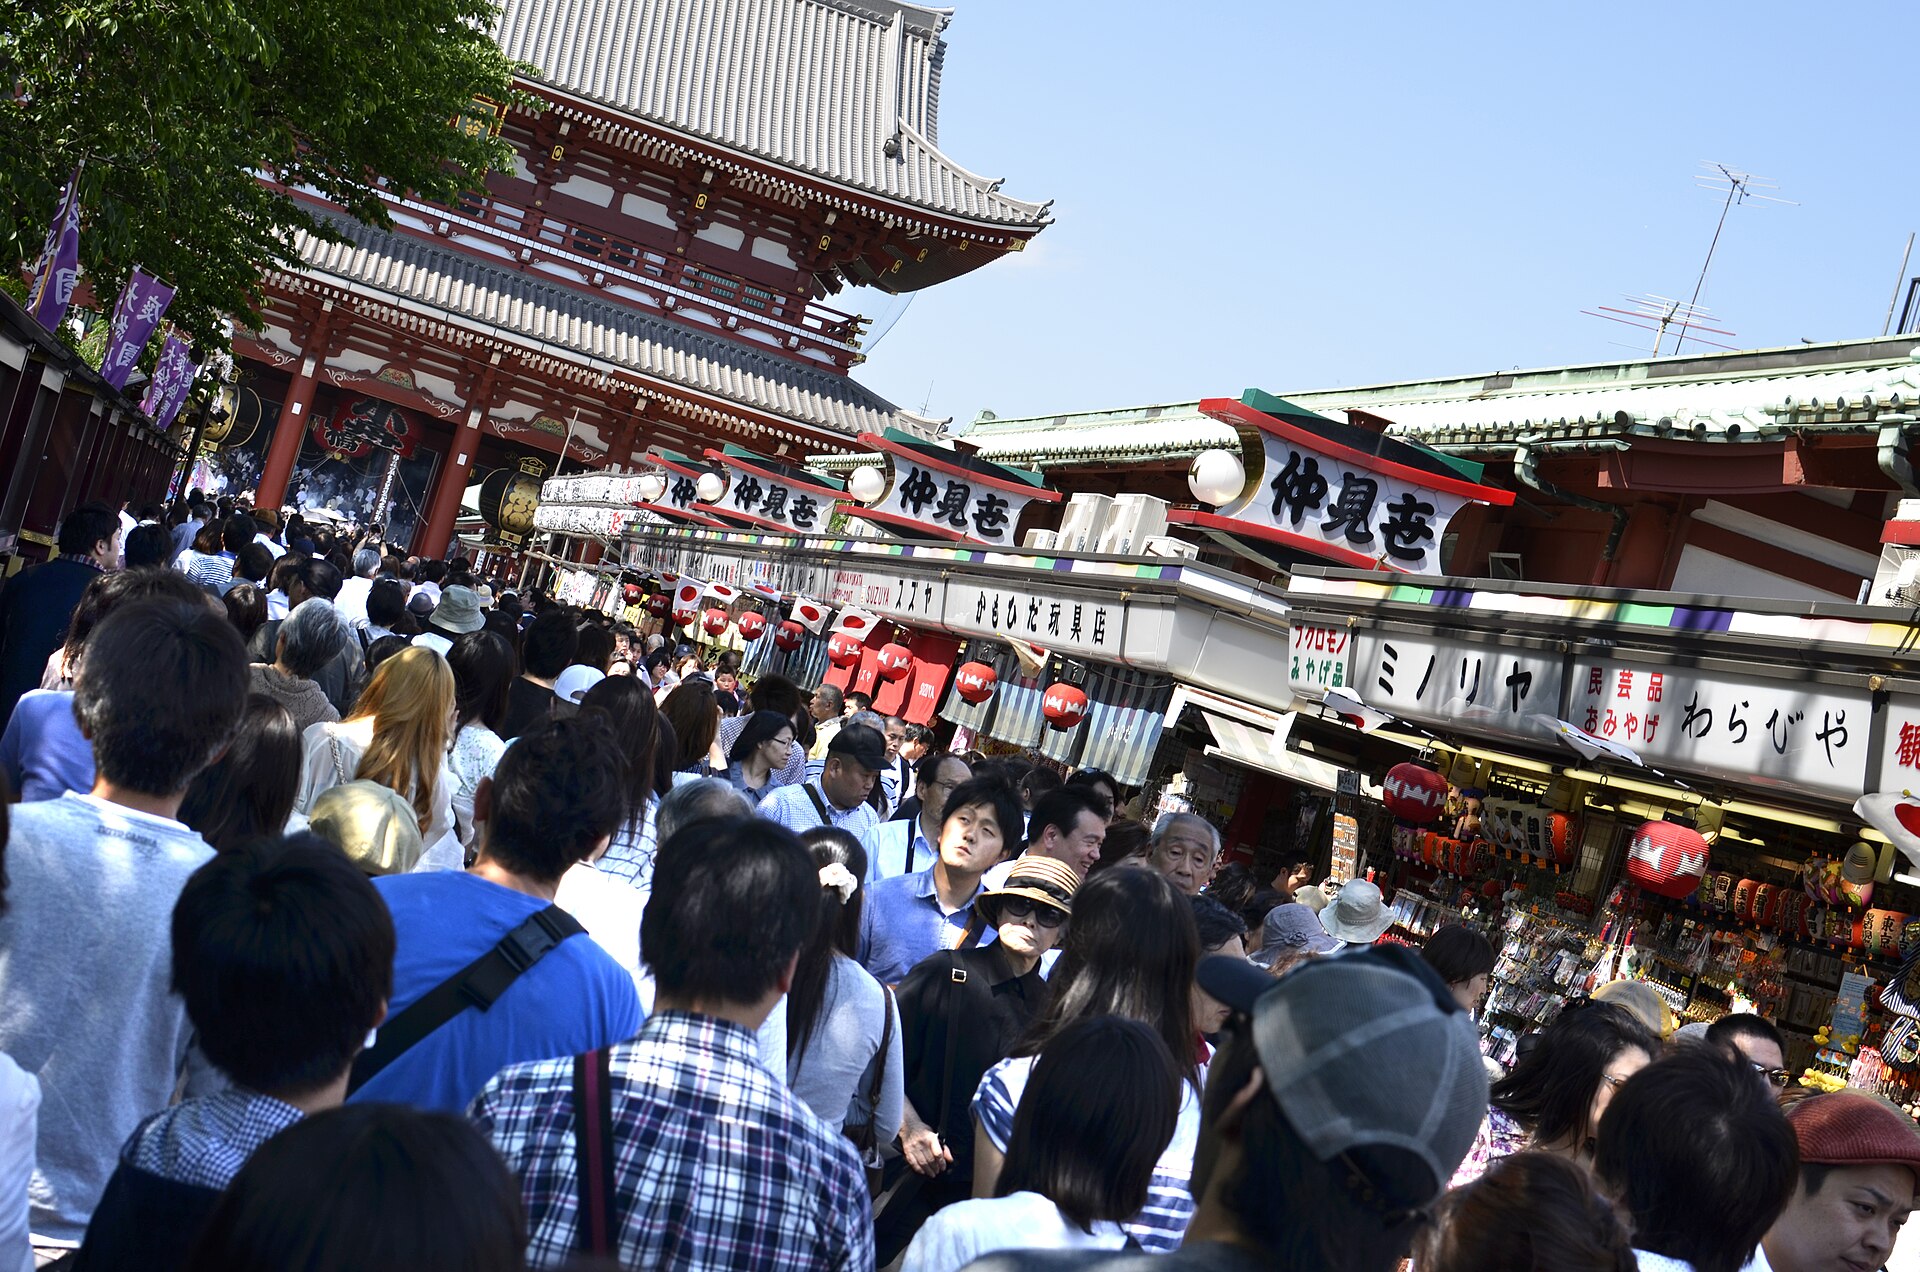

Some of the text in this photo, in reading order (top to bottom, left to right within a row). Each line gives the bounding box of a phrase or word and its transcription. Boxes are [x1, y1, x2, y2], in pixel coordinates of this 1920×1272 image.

[733, 474, 818, 528] 仲見世
[899, 466, 1010, 538] 仲見世
[1271, 451, 1436, 561] 仲見世
[866, 585, 890, 606] SUZUYA
[895, 579, 932, 614] スズヤ
[975, 590, 1107, 646] かもひだ玩具店
[1295, 625, 1347, 655] フクロモノ
[1291, 655, 1343, 688] みやげ品
[1378, 642, 1532, 713] ミノリヤ
[1588, 667, 1663, 702] 民芸品
[1584, 704, 1661, 743] おみやげ
[1681, 690, 1849, 768] わらびや
[1880, 915, 1896, 950] 東京
